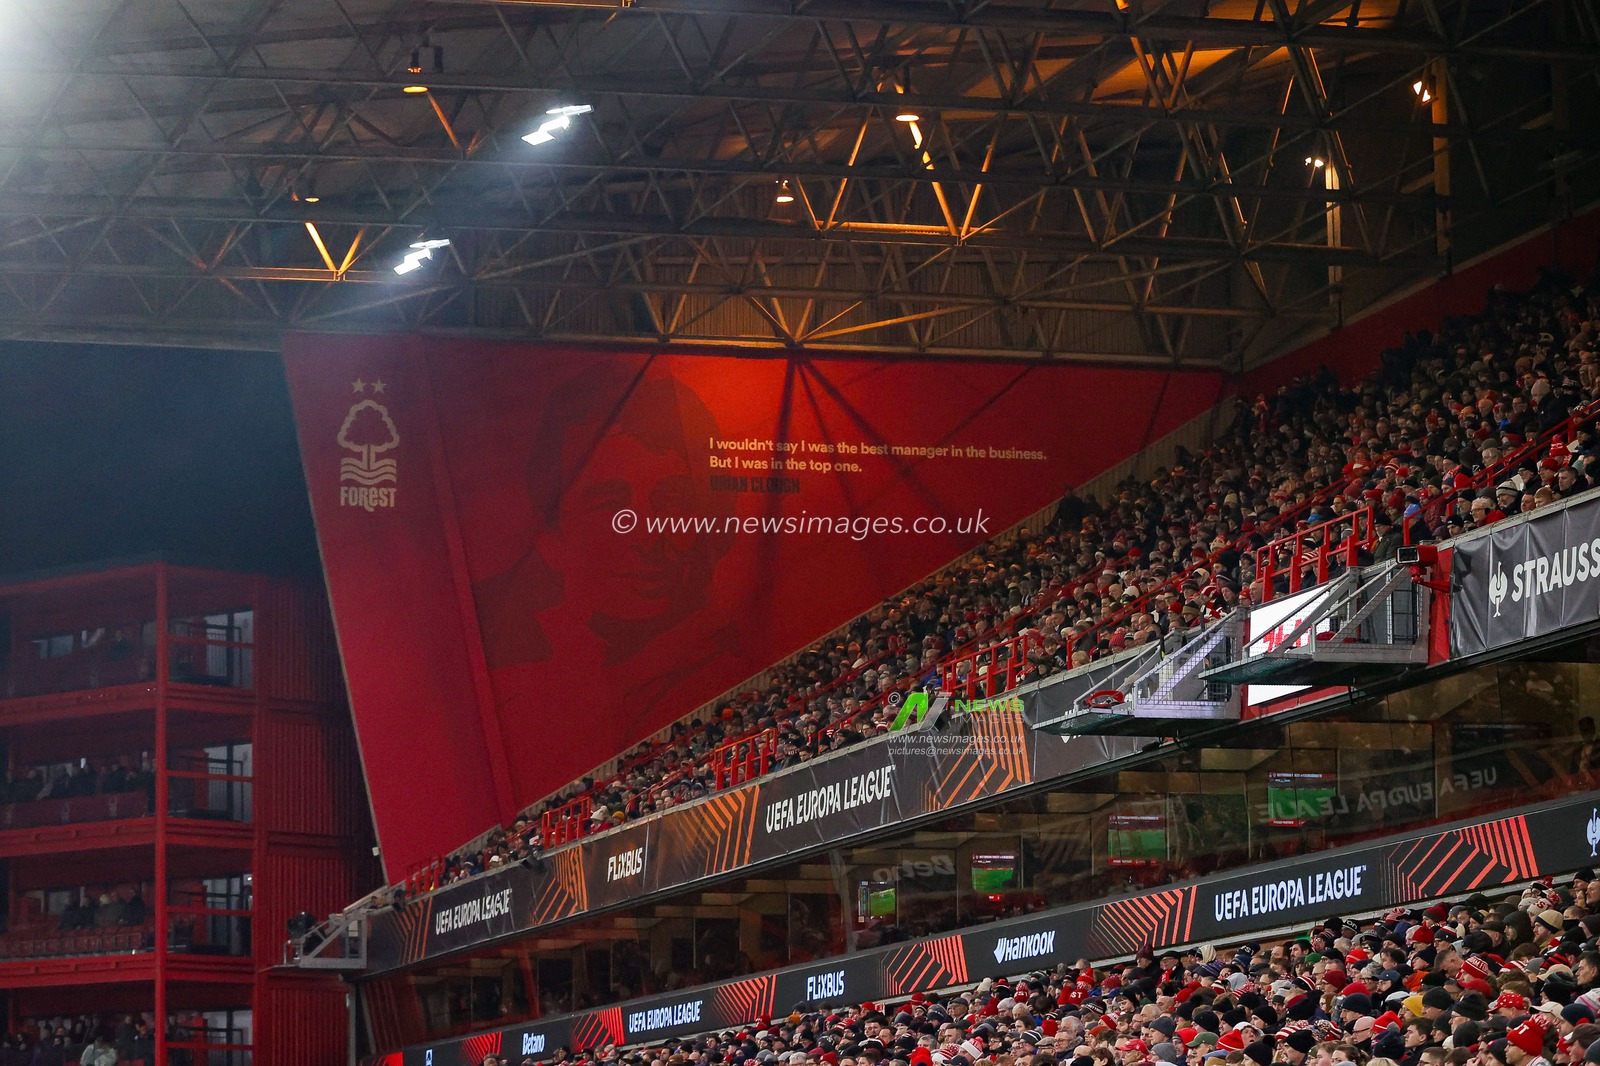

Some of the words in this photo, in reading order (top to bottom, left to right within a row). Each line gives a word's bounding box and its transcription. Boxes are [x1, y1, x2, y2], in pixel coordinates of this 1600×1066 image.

[709, 456, 732, 468] But
[742, 460, 768, 469] was
[771, 458, 783, 469] in
[786, 458, 806, 470] the
[809, 460, 831, 473] top
[834, 462, 862, 472] one.
[716, 438, 773, 451] wouldn't
[776, 442, 798, 454] say
[808, 443, 834, 453] was
[836, 442, 858, 454] the
[861, 443, 889, 455] best
[891, 445, 949, 459] manager
[951, 445, 963, 457] in
[965, 446, 986, 458] the
[989, 447, 1048, 460] business.
[1511, 537, 1600, 602] STRAUSS
[766, 798, 794, 833] UEFA
[796, 783, 841, 824] EUROPA
[1215, 889, 1249, 921] UEFA
[1251, 878, 1305, 915] EUROPA
[435, 908, 453, 935] UEFA
[453, 899, 481, 929] EUROPA
[629, 1011, 646, 1033] UEFA
[647, 1006, 673, 1030] EUROPA
[522, 1032, 545, 1055] Betano
